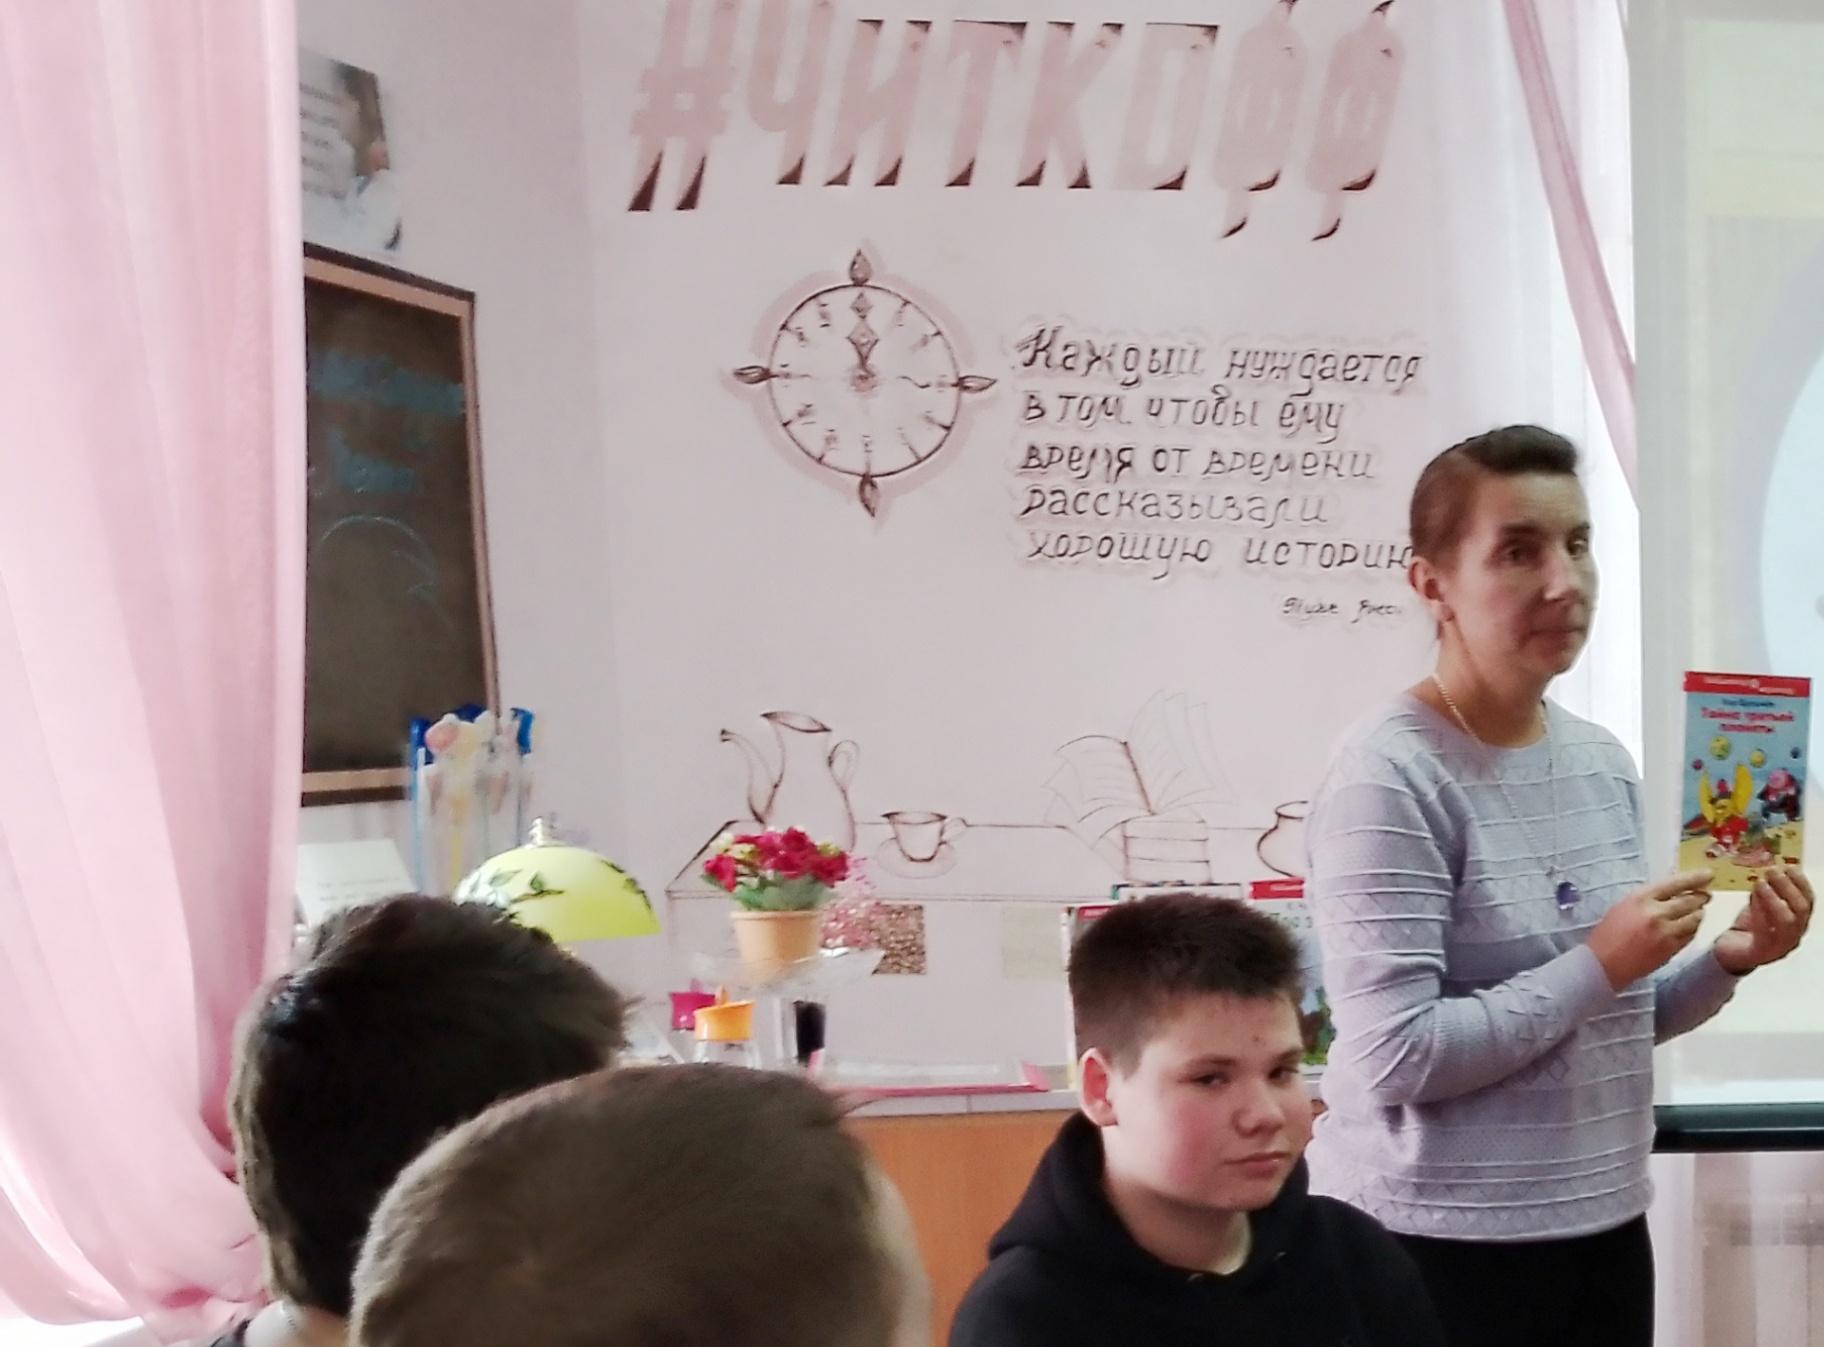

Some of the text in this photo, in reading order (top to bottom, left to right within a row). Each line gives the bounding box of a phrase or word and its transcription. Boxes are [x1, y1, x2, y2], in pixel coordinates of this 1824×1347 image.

[1015, 325, 1424, 397] Каждый нуждается
[1147, 384, 1260, 427] чтобы
[1278, 400, 1344, 444] ему
[1019, 444, 1376, 484] время от времени
[1019, 485, 1329, 529] рассказывали
[1027, 531, 1211, 581] хорошую
